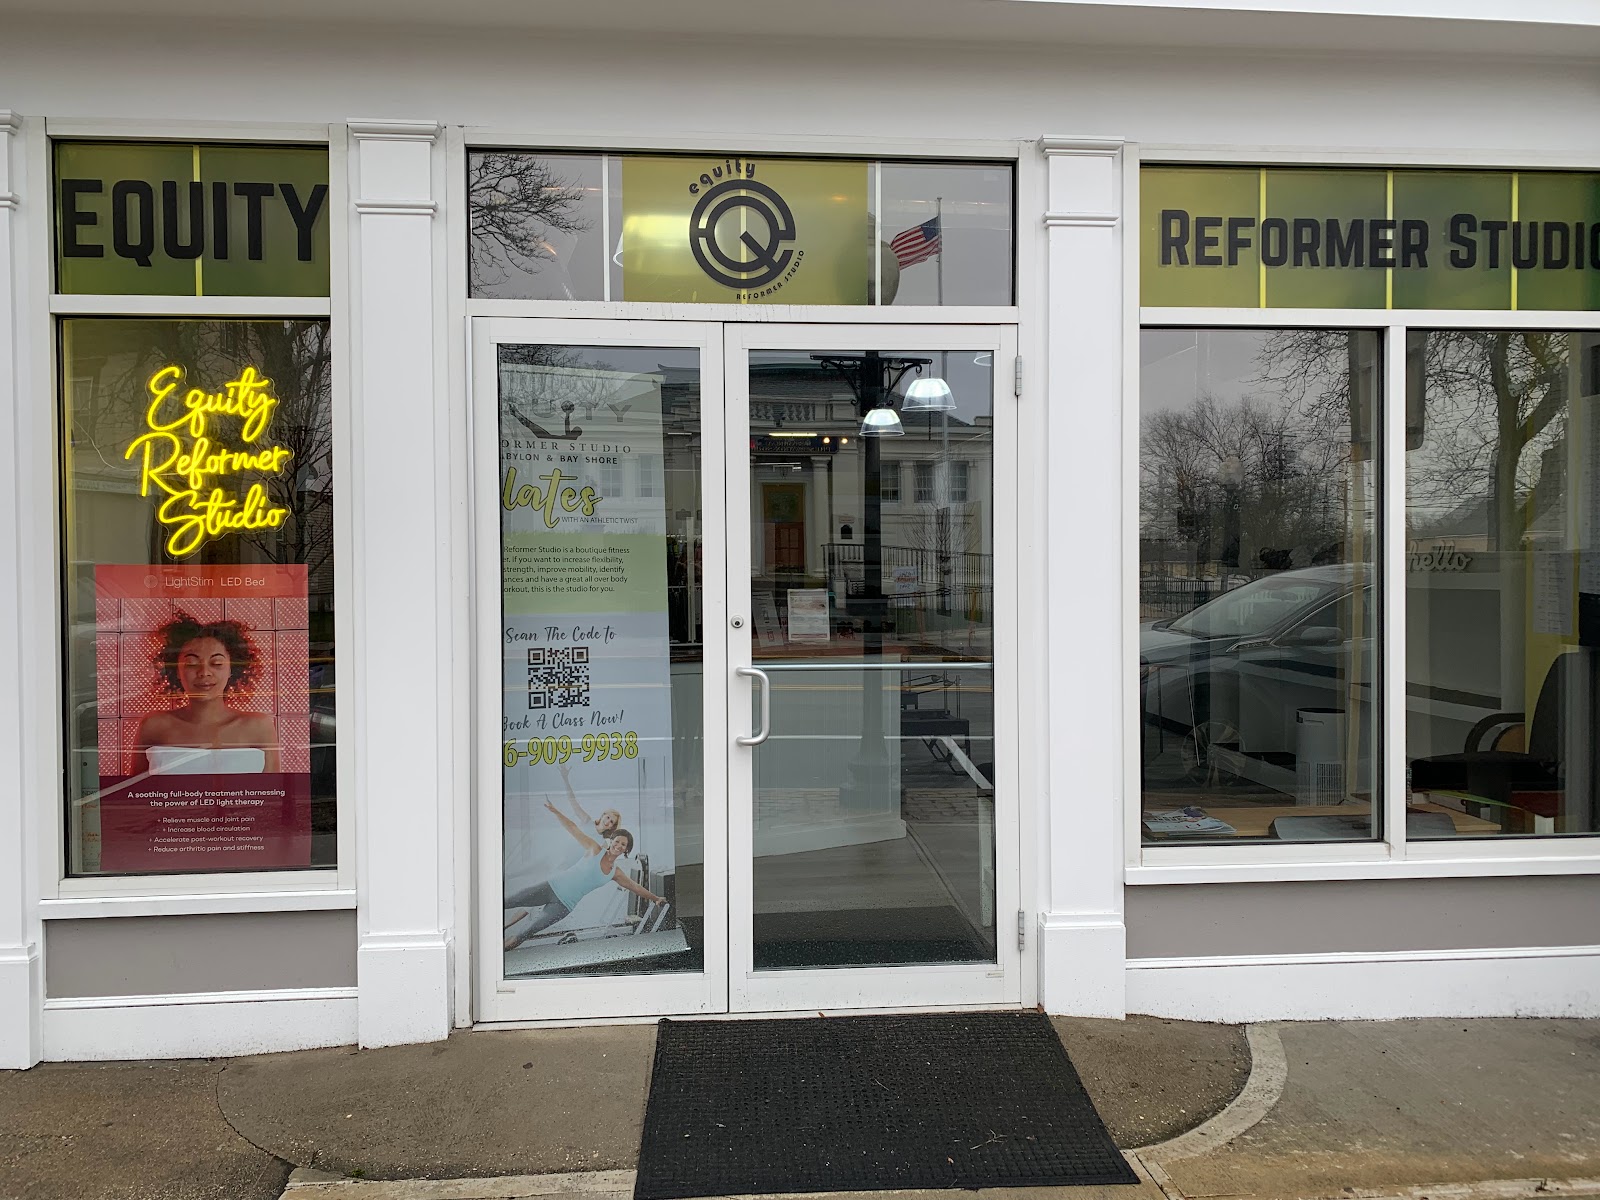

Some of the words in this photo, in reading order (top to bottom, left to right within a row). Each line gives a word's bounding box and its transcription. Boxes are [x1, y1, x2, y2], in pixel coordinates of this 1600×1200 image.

[689, 158, 755, 194] equity
[61, 178, 328, 267] EQUITY
[1161, 209, 1429, 268] REFORMER
[736, 282, 783, 300] REFORMER
[784, 250, 805, 282] STUDIO
[147, 366, 276, 442] Equity
[569, 442, 632, 453] STUDIO
[124, 431, 290, 497] Reformer
[560, 455, 579, 463] BAY
[585, 456, 618, 465] SHORE
[502, 466, 604, 528] lates
[159, 483, 286, 556] Studio
[590, 516, 619, 524] ATHLETIC
[538, 545, 562, 553] Studio
[576, 546, 607, 555] boutique
[1407, 539, 1474, 574] hello
[518, 557, 532, 565] you
[591, 556, 624, 564] flexibility,
[537, 566, 567, 574] improve
[568, 566, 598, 574] mobility,
[599, 566, 625, 574] identify
[165, 576, 214, 589] LightStim
[220, 577, 242, 587] LED
[245, 577, 265, 587] Bed
[610, 575, 628, 584] body
[531, 585, 546, 593] this
[547, 585, 552, 593] is
[552, 585, 565, 593] the
[565, 585, 588, 593] studio
[589, 585, 600, 593] for
[600, 586, 615, 595] you.
[505, 627, 540, 644] Scan
[544, 626, 568, 643] The
[572, 625, 602, 642] Code
[602, 625, 618, 645] to
[503, 714, 531, 732] Book
[536, 713, 548, 730] A
[552, 711, 586, 729] Class
[590, 709, 625, 726] Now!
[503, 731, 639, 767] 6-909-9938
[135, 790, 169, 799] soothing
[170, 790, 204, 798] full-body
[204, 789, 244, 797] treatment
[244, 789, 286, 797] harnessing
[216, 799, 234, 807] light
[234, 799, 265, 807] therapy
[224, 816, 240, 824] joint
[190, 835, 235, 843] post-workout
